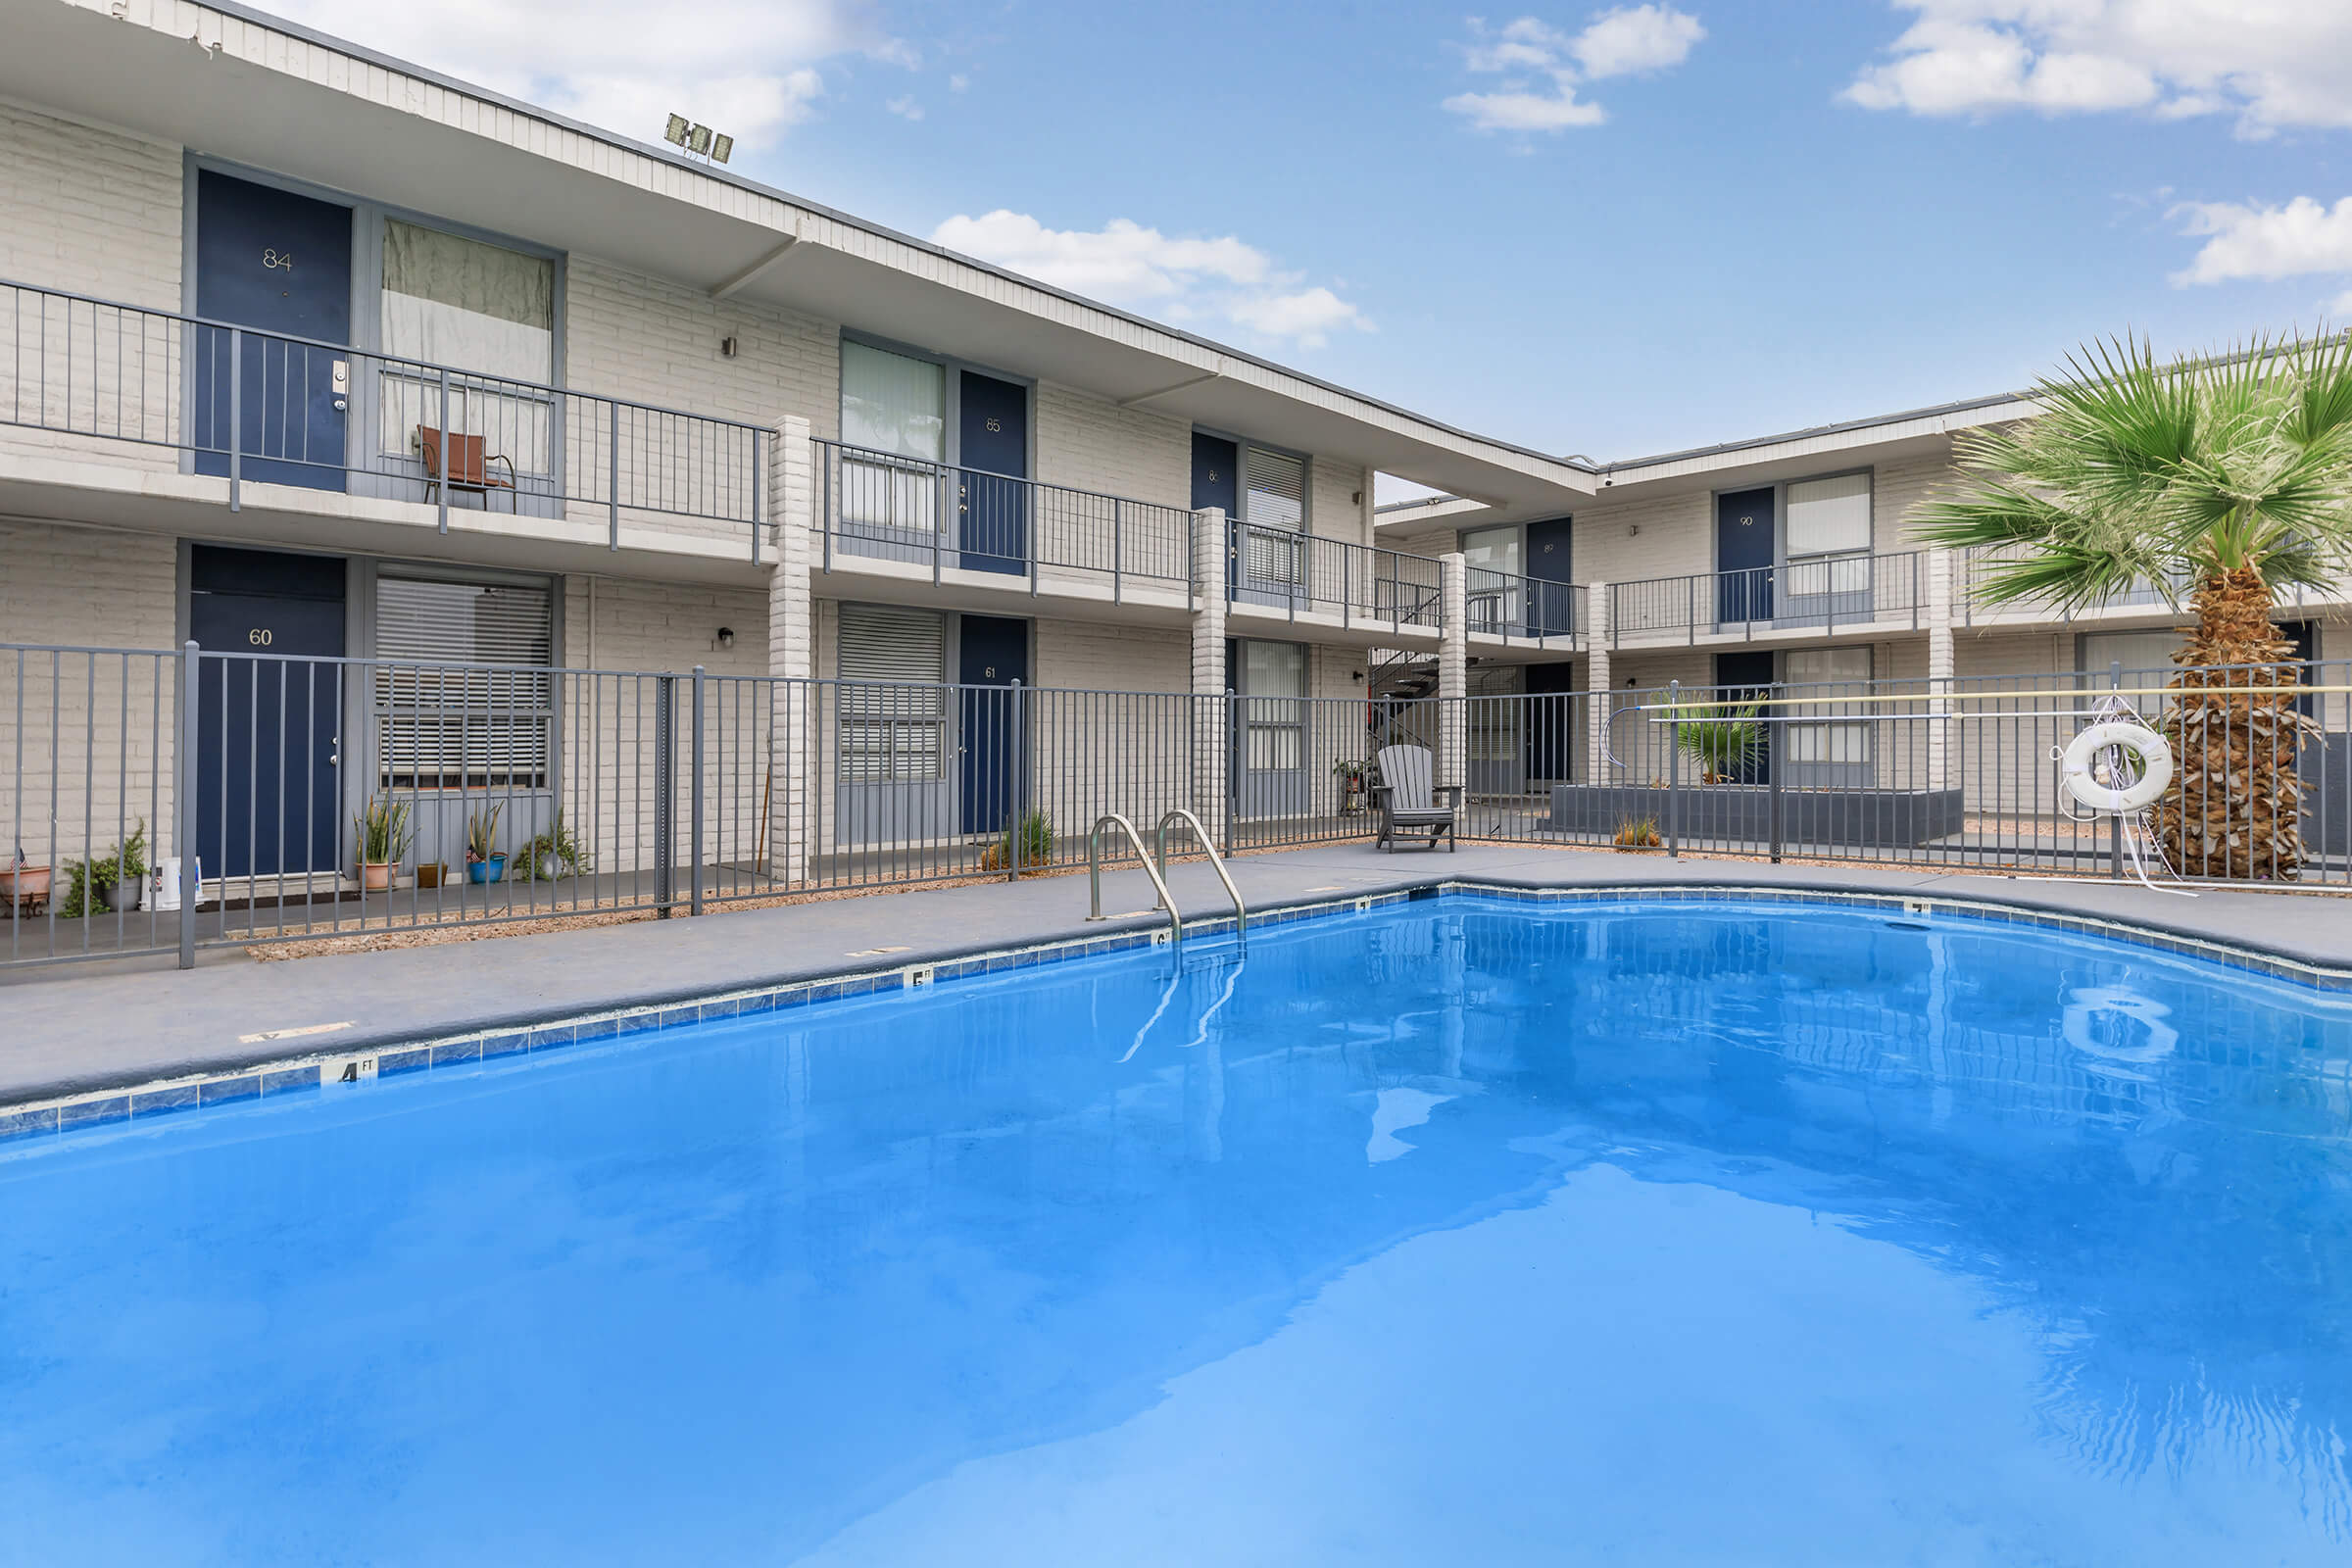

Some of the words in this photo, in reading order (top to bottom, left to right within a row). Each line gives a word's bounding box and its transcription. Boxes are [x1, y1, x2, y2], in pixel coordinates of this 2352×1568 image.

[264, 248, 292, 271] 84
[1740, 516, 1752, 525] 90
[250, 628, 272, 645] 60
[986, 666, 995, 678] 61
[337, 1062, 358, 1082] 4
[363, 1059, 372, 1071] FT
